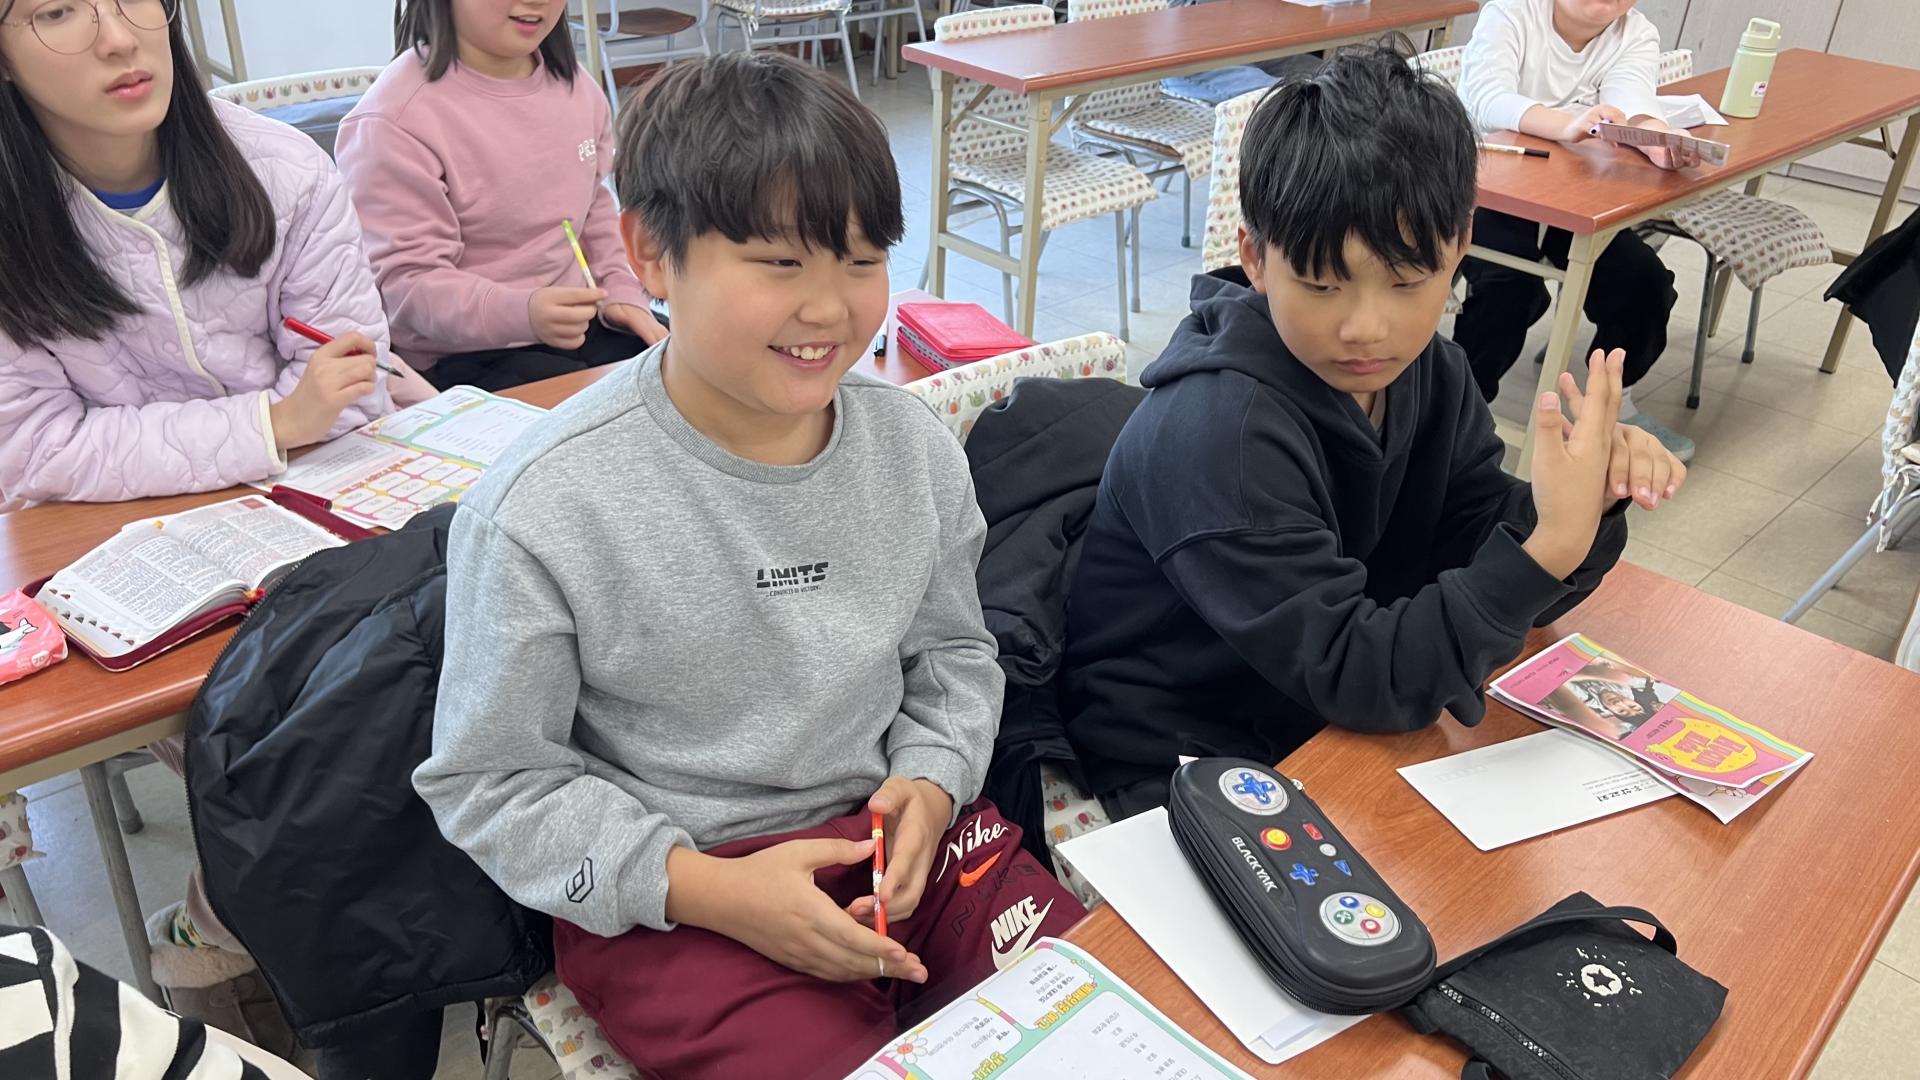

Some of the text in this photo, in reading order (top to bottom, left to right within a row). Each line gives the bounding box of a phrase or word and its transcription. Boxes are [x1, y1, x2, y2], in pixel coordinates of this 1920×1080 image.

[756, 561, 829, 588] LIMITS
[936, 814, 1009, 884] Nike
[1231, 836, 1278, 893] BLACKYAK
[990, 895, 1042, 950] NIKE
